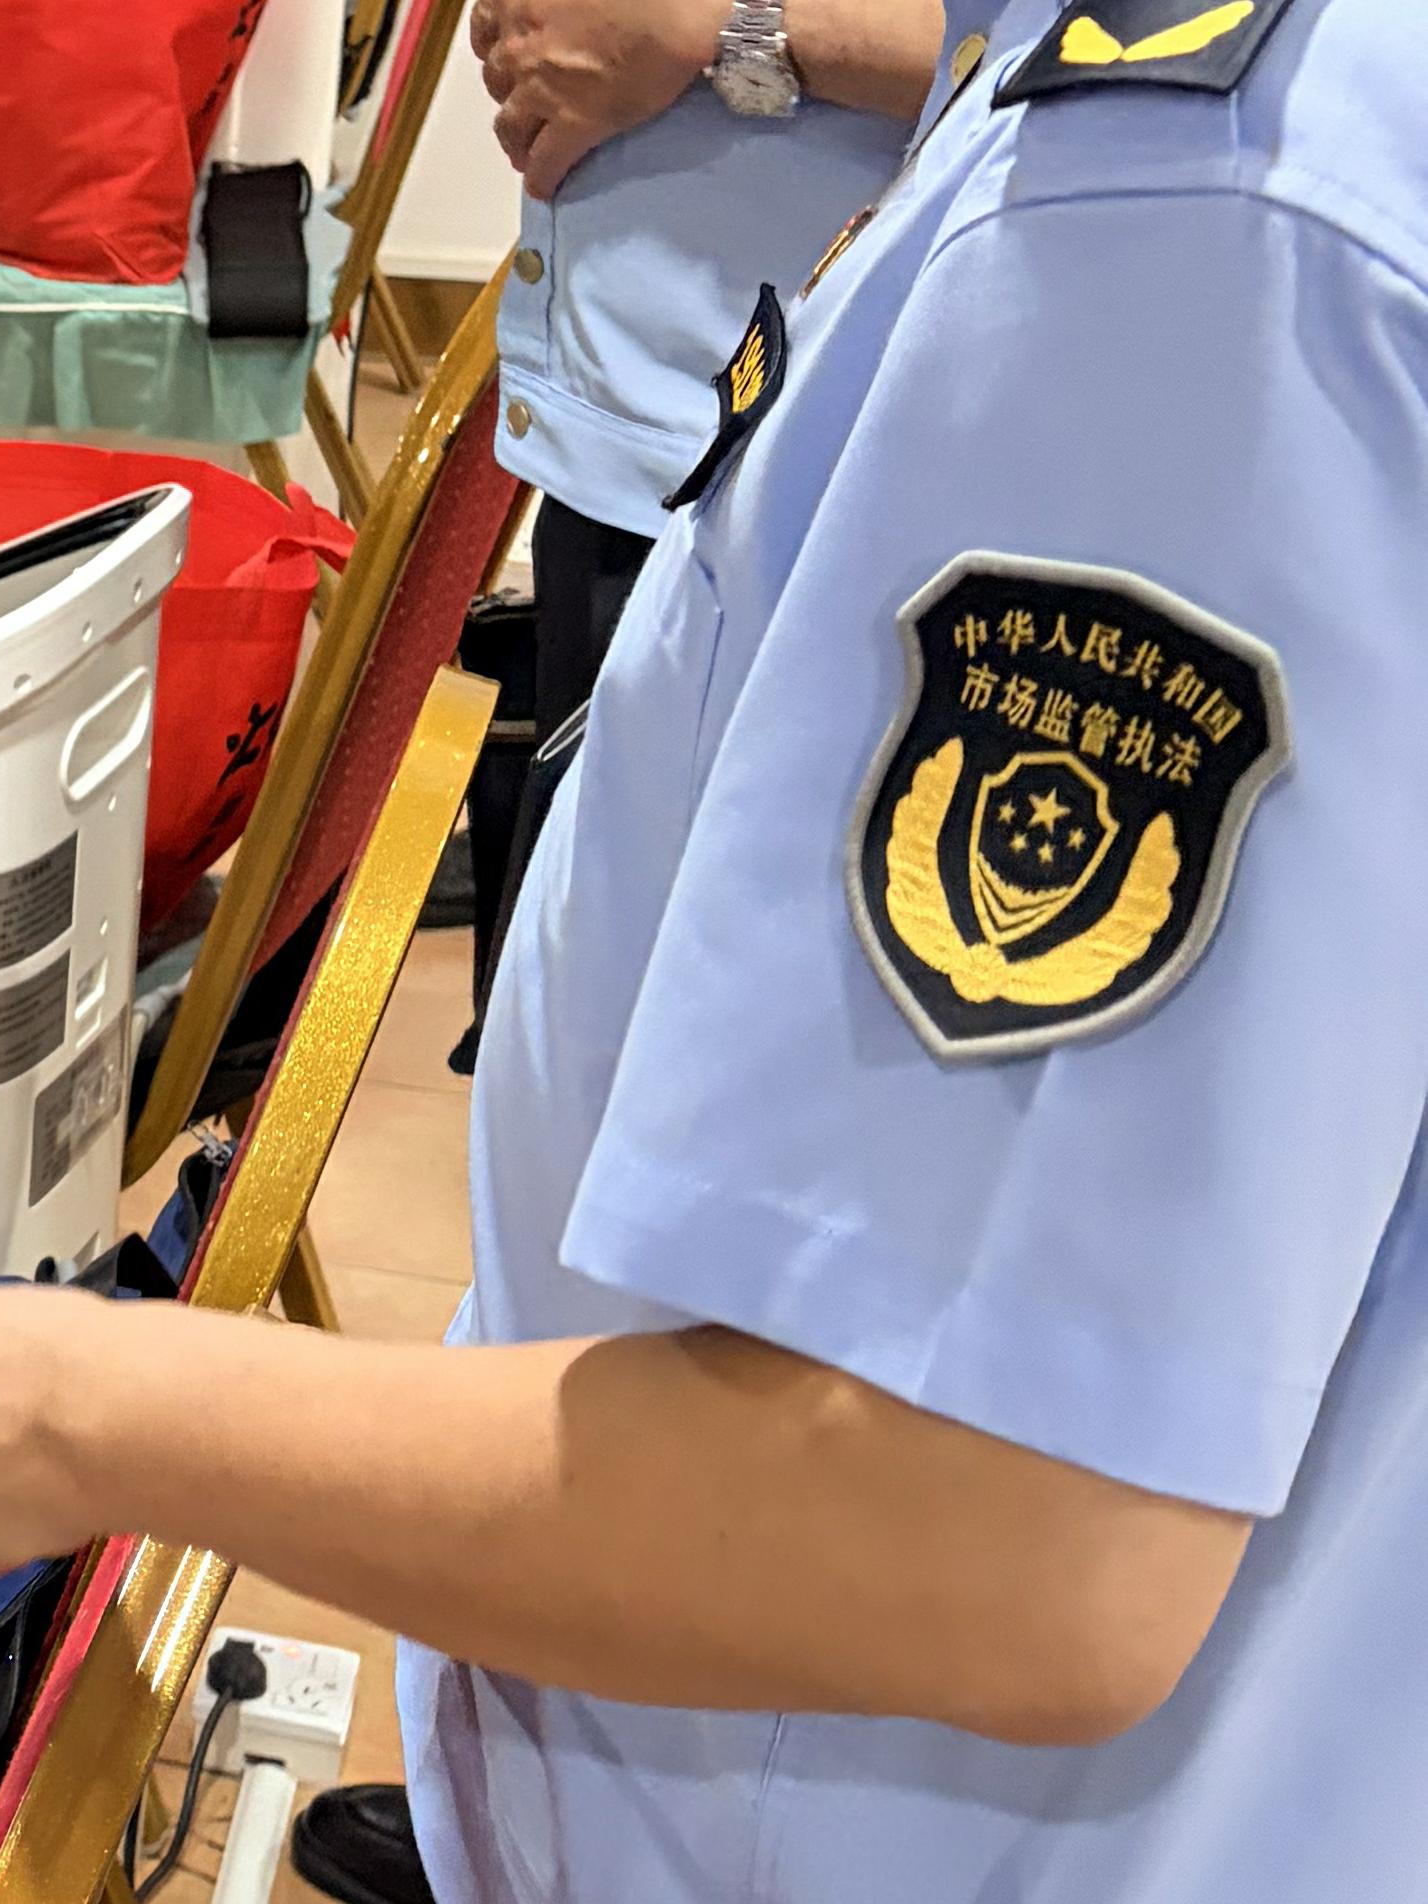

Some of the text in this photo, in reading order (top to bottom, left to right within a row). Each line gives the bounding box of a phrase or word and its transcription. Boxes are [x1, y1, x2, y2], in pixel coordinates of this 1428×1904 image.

[954, 609, 1243, 746] 中华人民共和国
[960, 663, 1202, 787] 市场监管执法
